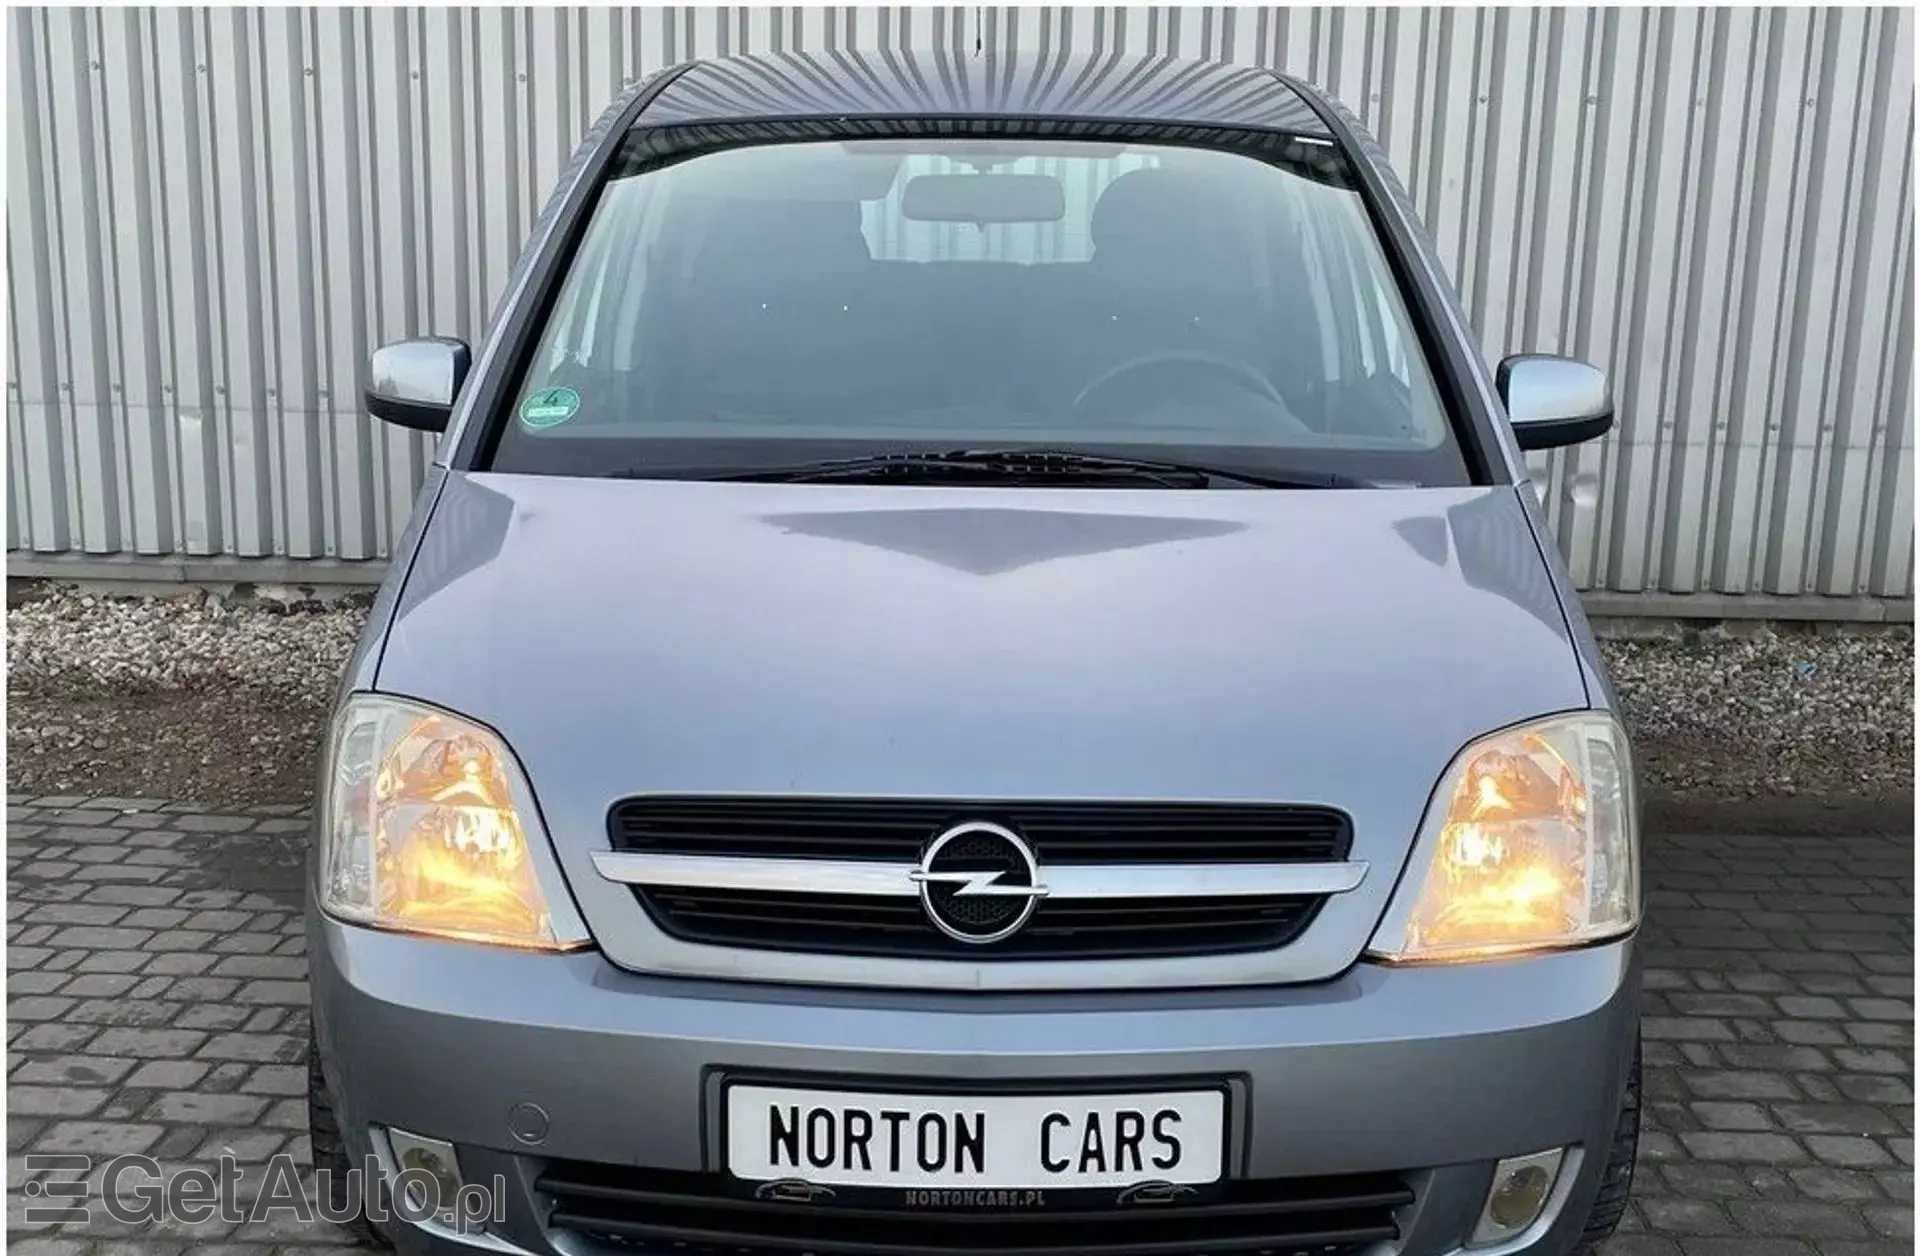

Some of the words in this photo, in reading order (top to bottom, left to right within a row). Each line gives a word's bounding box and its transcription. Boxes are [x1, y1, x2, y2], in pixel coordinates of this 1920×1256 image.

[769, 1105, 985, 1173] NORTON
[1040, 1109, 1182, 1173] CARS
[905, 1190, 1046, 1206] NORTONCARS.PL
